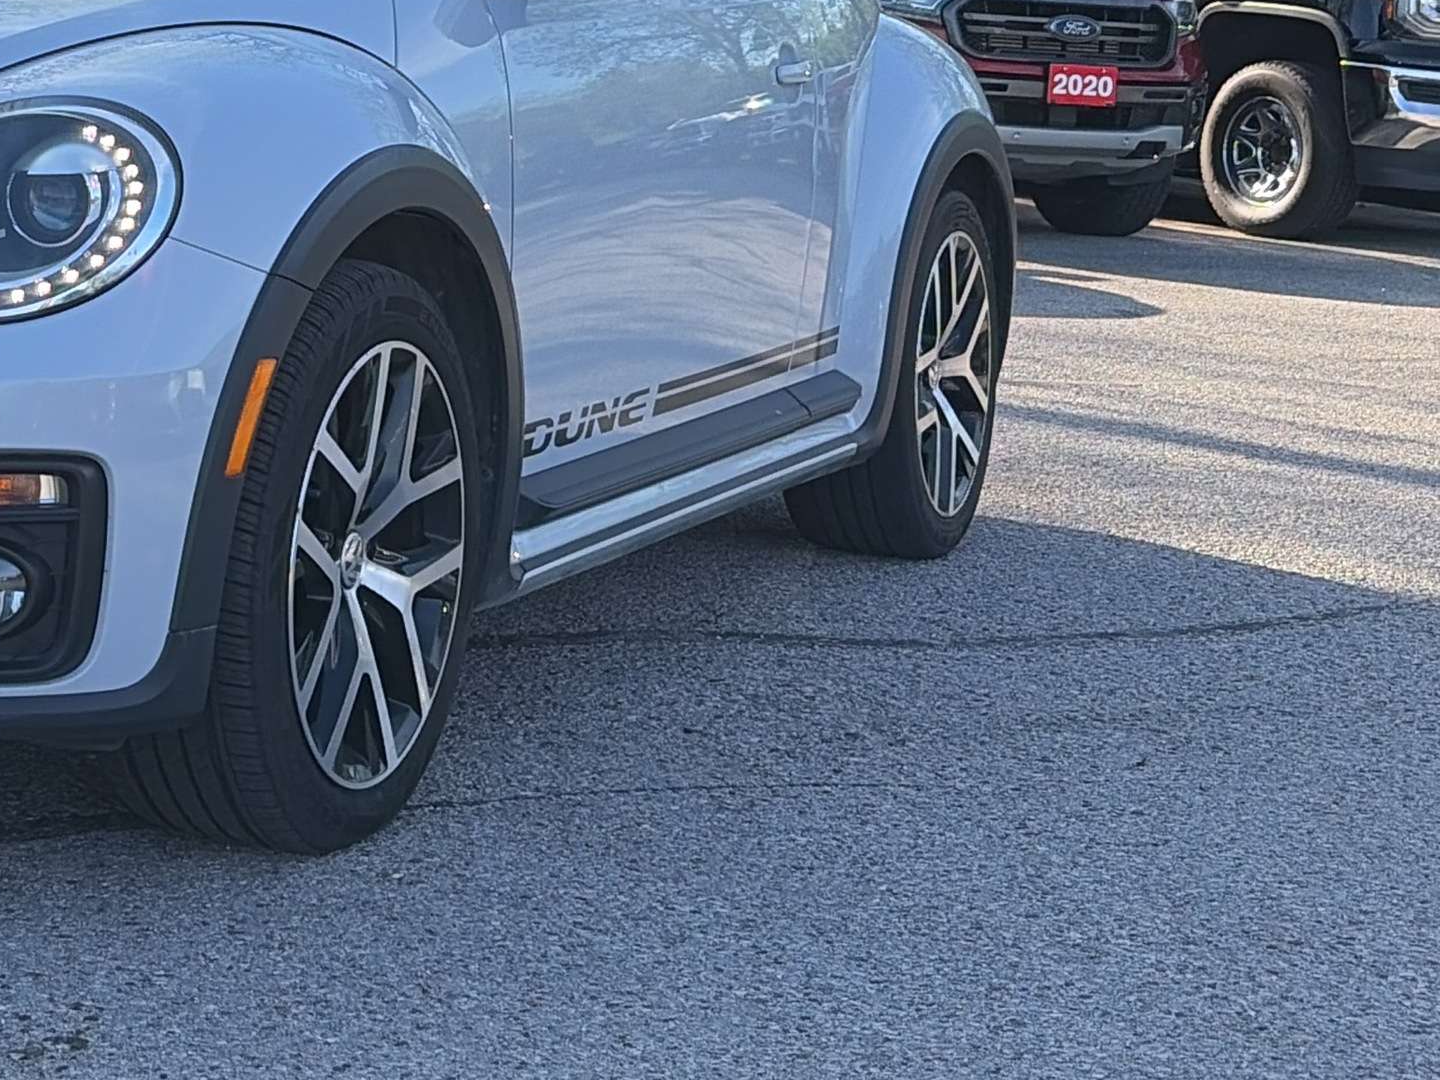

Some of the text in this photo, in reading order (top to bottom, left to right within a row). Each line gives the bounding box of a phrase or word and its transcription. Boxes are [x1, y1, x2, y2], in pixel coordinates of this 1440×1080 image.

[1063, 21, 1090, 35] Ford
[1052, 73, 1114, 97] 2020
[522, 387, 650, 458] DUNE
